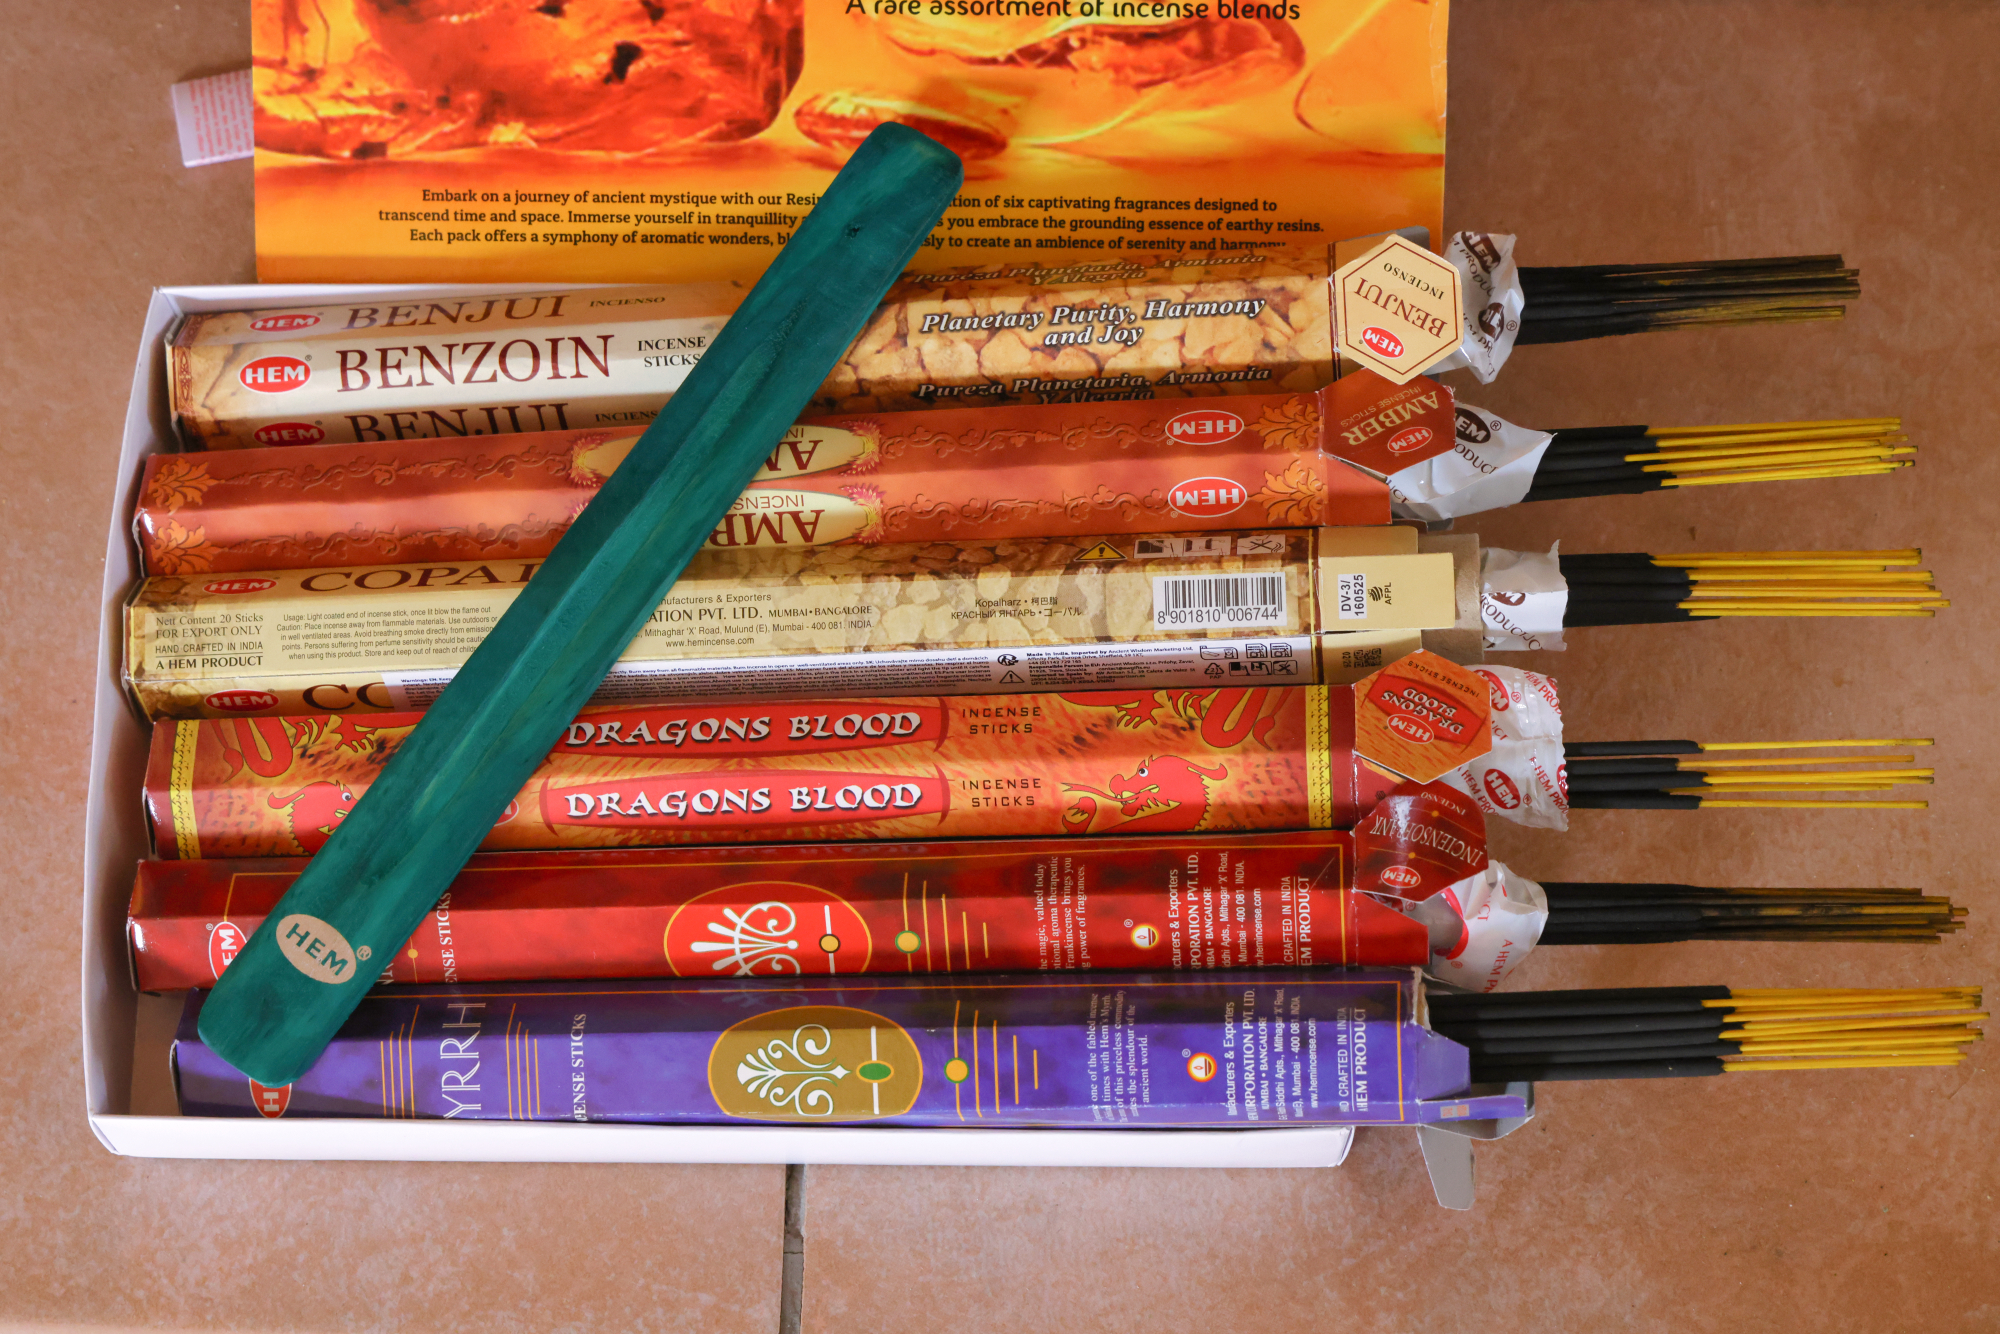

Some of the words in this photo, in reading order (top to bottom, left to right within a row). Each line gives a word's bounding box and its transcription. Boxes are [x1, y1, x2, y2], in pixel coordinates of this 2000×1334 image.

[845, 0, 866, 15] A
[874, 0, 921, 15] rare
[929, 0, 1071, 16] assortment
[1079, 0, 1101, 17] of
[1112, 0, 1208, 18] incense
[1217, 0, 1302, 20] blends
[422, 189, 477, 202] Embark
[514, 190, 570, 206] journey
[592, 191, 646, 203] ancient
[649, 192, 717, 207] mystique
[721, 192, 754, 205] with
[758, 194, 782, 205] our
[1003, 196, 1024, 208] six
[1028, 197, 1110, 213] captivating
[1114, 197, 1191, 213] fragrances
[1194, 198, 1259, 214] designed
[379, 209, 449, 221] transcend
[453, 209, 487, 222] time
[490, 210, 517, 222] and
[521, 212, 564, 226] space.
[568, 211, 631, 223] Immerse
[634, 212, 694, 227] yourself
[716, 213, 798, 228] tranquillity
[947, 217, 974, 231] you
[978, 215, 1039, 228] embrace
[1043, 216, 1066, 229] the
[1070, 216, 1145, 232] grounding
[1149, 219, 1204, 230] essence
[1226, 219, 1274, 234] earthy
[1277, 219, 1324, 232] resins.
[410, 229, 443, 242] Each
[447, 229, 481, 244] pack
[484, 229, 527, 242] offers
[543, 230, 619, 246] symphony
[641, 231, 704, 244] aromatic
[708, 232, 774, 247] wonders,
[967, 236, 1010, 248] create
[1036, 235, 1104, 249] ambience
[1127, 237, 1186, 252] serenity
[1189, 238, 1217, 251] and
[914, 271, 1001, 283] Pureza
[1383, 262, 1445, 300] INCIENSO
[254, 315, 316, 329] HEM
[341, 295, 570, 330] BENJUI
[589, 296, 666, 308] INCIENSO
[921, 311, 1045, 333] Planetary
[1051, 301, 1138, 325] Purity,
[1144, 298, 1266, 320] Harmony
[1354, 277, 1448, 338] BENJUI
[637, 336, 707, 352] INCENSE
[1043, 326, 1093, 346] and
[1097, 324, 1144, 346] Joy
[1364, 328, 1403, 357] HEM
[244, 364, 306, 385] HEM
[336, 334, 615, 393] BENZOIN
[644, 353, 702, 368] STICKS
[918, 383, 1004, 398] Pureza
[1013, 371, 1152, 393] Planetaria,
[1379, 386, 1421, 409] INCENSE
[257, 427, 322, 445] HEM
[344, 402, 569, 443] BENJUI
[595, 409, 661, 423] INCIENS
[1173, 419, 1237, 436] HEM
[1340, 390, 1440, 447] AMBER
[1341, 406, 1377, 429] STICKS
[1390, 429, 1431, 452] HEM
[1175, 488, 1240, 507] HEM
[703, 509, 826, 548] AMB
[206, 580, 272, 593] HEM
[726, 593, 772, 604] Exporters
[1340, 580, 1351, 612] DV-3/
[1353, 574, 1365, 617] 160525
[1384, 582, 1392, 605] AFPL
[698, 607, 727, 621] PVT.
[733, 606, 763, 620] LTD.
[951, 608, 997, 620] КРАСНЫЙ
[998, 607, 1036, 618] ЯНТАРЬ
[975, 597, 1022, 609] Kopalharz
[1157, 610, 1167, 625] 8
[1170, 608, 1221, 624] 901810
[1227, 606, 1278, 622] 006744
[155, 628, 179, 639] FOR
[182, 627, 228, 638] EXPORT
[230, 625, 263, 636] ONLY
[156, 616, 176, 627] Nett
[179, 615, 216, 626] Content
[219, 614, 232, 624] 20
[235, 613, 264, 623] Sticks
[699, 624, 722, 636] Road,
[724, 623, 754, 634] Mulund
[772, 621, 804, 633] Mumbai
[811, 620, 826, 630] 400
[155, 644, 179, 654] HAND
[182, 642, 224, 653] CRAFTED
[227, 641, 236, 651] IN
[239, 640, 263, 651] INDIA
[665, 635, 755, 648] www.hemincense.com
[155, 660, 164, 670] A
[168, 658, 197, 670] HEM
[201, 655, 264, 668] PRODUCT
[1407, 660, 1440, 681] STICKS
[1440, 674, 1481, 699] INCENSE
[209, 695, 273, 708] HEM
[962, 706, 1041, 718] INCENSE
[1380, 690, 1465, 735] DRAGONS
[1402, 686, 1458, 718] BLOOD
[565, 716, 772, 747] DRAGONS
[788, 711, 922, 738] BLOOD
[969, 723, 1034, 735] STICKS
[1389, 716, 1432, 742] HEM
[962, 778, 1042, 791] INCENSE
[1486, 771, 1519, 810] HEM
[564, 787, 772, 819] DRAGONS
[788, 783, 923, 811] BLOOD
[971, 795, 1036, 808] STICKS
[1420, 791, 1467, 816] INCIENSO
[1034, 863, 1047, 887] today
[1065, 857, 1074, 873] you
[1187, 852, 1199, 874] LTD.
[1187, 876, 1199, 901] PVT.
[1281, 876, 1291, 902] INDIA
[1383, 869, 1419, 885] HEM
[1061, 875, 1074, 905] brings
[1168, 868, 1180, 918] Exporters
[1034, 890, 1044, 921] valued
[1203, 886, 1213, 940] BANGALORE
[1298, 876, 1311, 943] PRODUCT
[436, 892, 453, 945] STICKS
[284, 922, 349, 977] HEM
[1036, 924, 1048, 956] magic,
[1080, 930, 1090, 959] power
[1282, 918, 1294, 963] CRAFTED
[1223, 1001, 1237, 1048] Exporters
[570, 1013, 587, 1068] STICKS
[1113, 1032, 1125, 1074] priceless
[1126, 1029, 1138, 1077] splendour
[1137, 1035, 1148, 1066] world.
[1258, 1016, 1268, 1071] BANGALORE
[1354, 1008, 1367, 1076] PRODUCT
[440, 1002, 487, 1120] YRRH
[1337, 1048, 1350, 1096] CRAFTED
[1140, 1068, 1150, 1103] ancient
